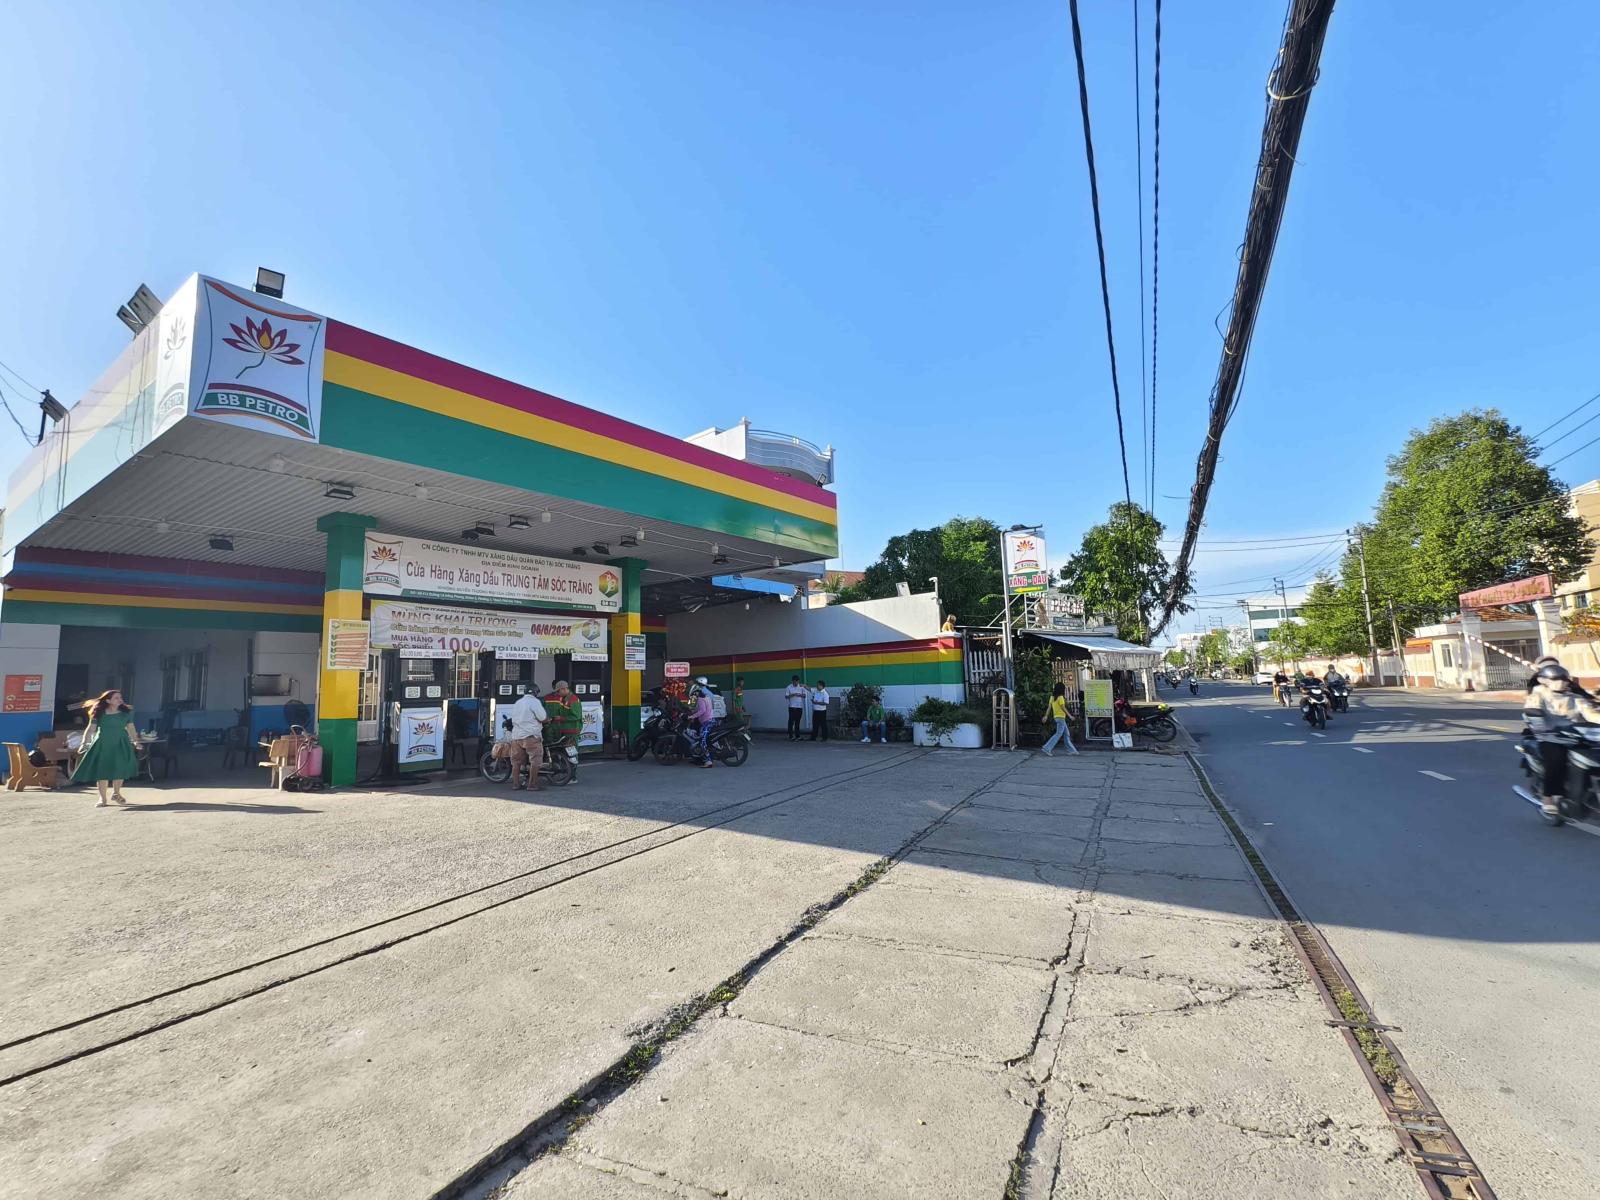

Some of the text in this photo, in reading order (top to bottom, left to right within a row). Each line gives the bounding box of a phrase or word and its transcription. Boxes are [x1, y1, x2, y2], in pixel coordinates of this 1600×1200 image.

[217, 392, 299, 423] BB PETRO
[406, 559, 425, 577] Cửa
[430, 563, 455, 585] Hàng
[458, 566, 481, 587] Xăng
[501, 572, 530, 589] TRUNG
[550, 575, 567, 593] SÓC
[568, 578, 593, 595] TRĂNG
[435, 612, 464, 624] KHAI
[531, 623, 572, 637] 06/6/2025
[391, 634, 409, 643] MUA
[437, 636, 487, 653] 100%
